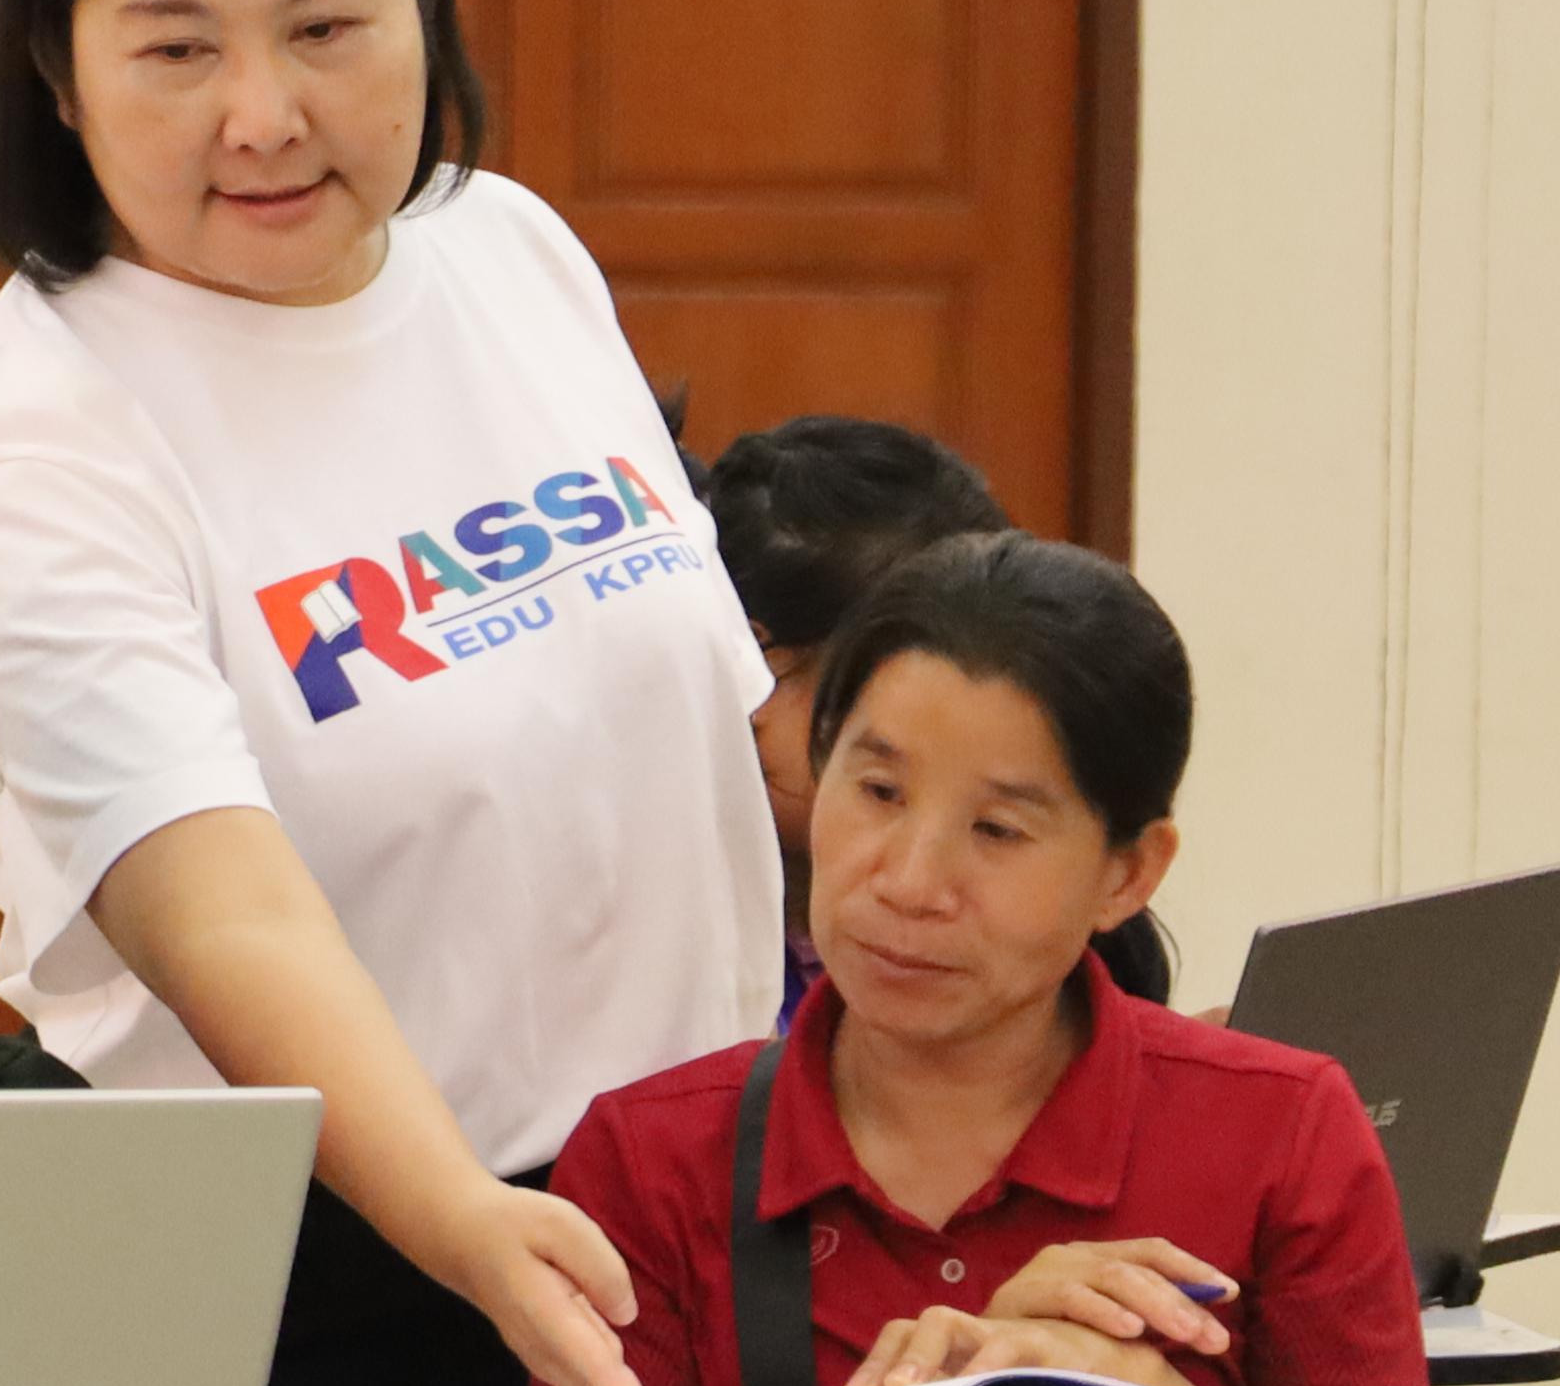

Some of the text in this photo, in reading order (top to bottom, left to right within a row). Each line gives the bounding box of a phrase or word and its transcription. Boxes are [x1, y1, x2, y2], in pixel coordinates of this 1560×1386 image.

[254, 456, 679, 724] RASSA
[441, 542, 704, 661] EDU KPRU
